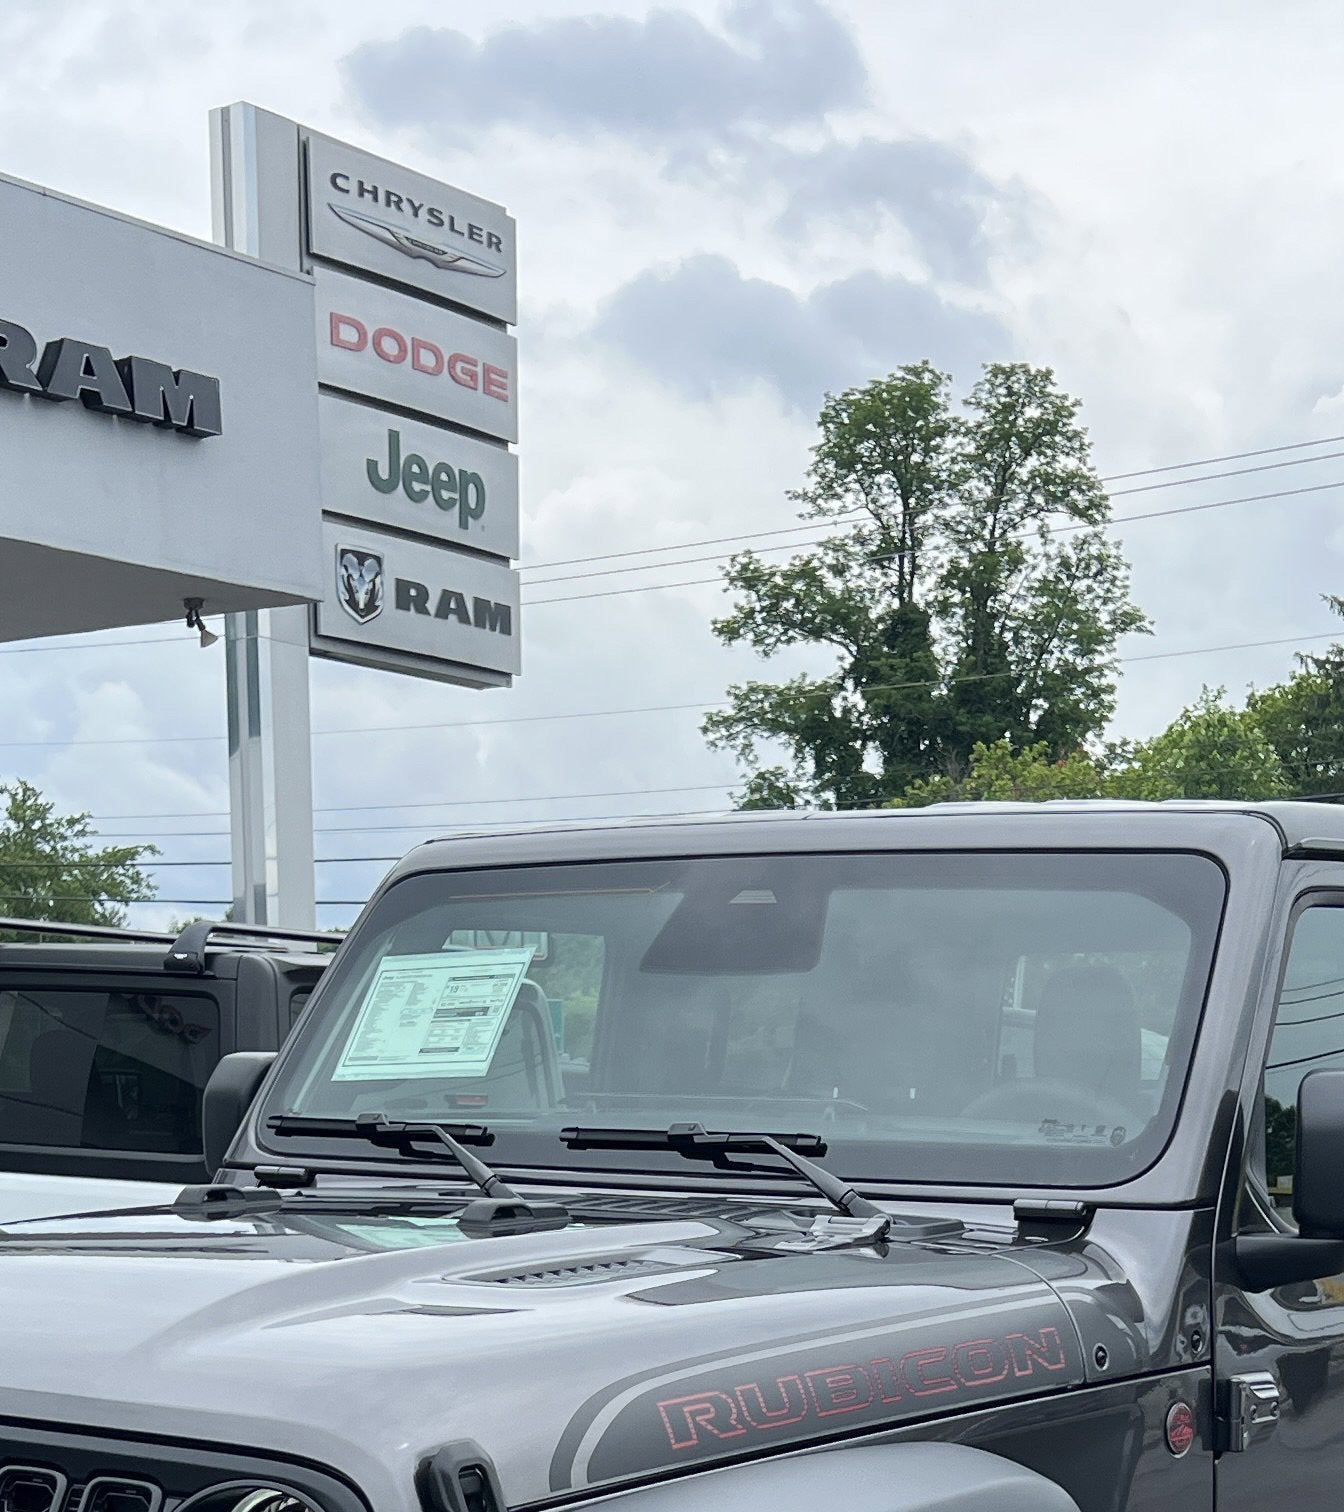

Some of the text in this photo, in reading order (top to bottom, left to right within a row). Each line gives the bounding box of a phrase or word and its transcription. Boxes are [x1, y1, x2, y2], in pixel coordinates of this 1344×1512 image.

[330, 172, 503, 254] CHRYSLER
[330, 312, 509, 402] DODGE
[366, 429, 486, 529] Jeep
[395, 578, 512, 635] RAM
[657, 1327, 1068, 1450] RUBICON
